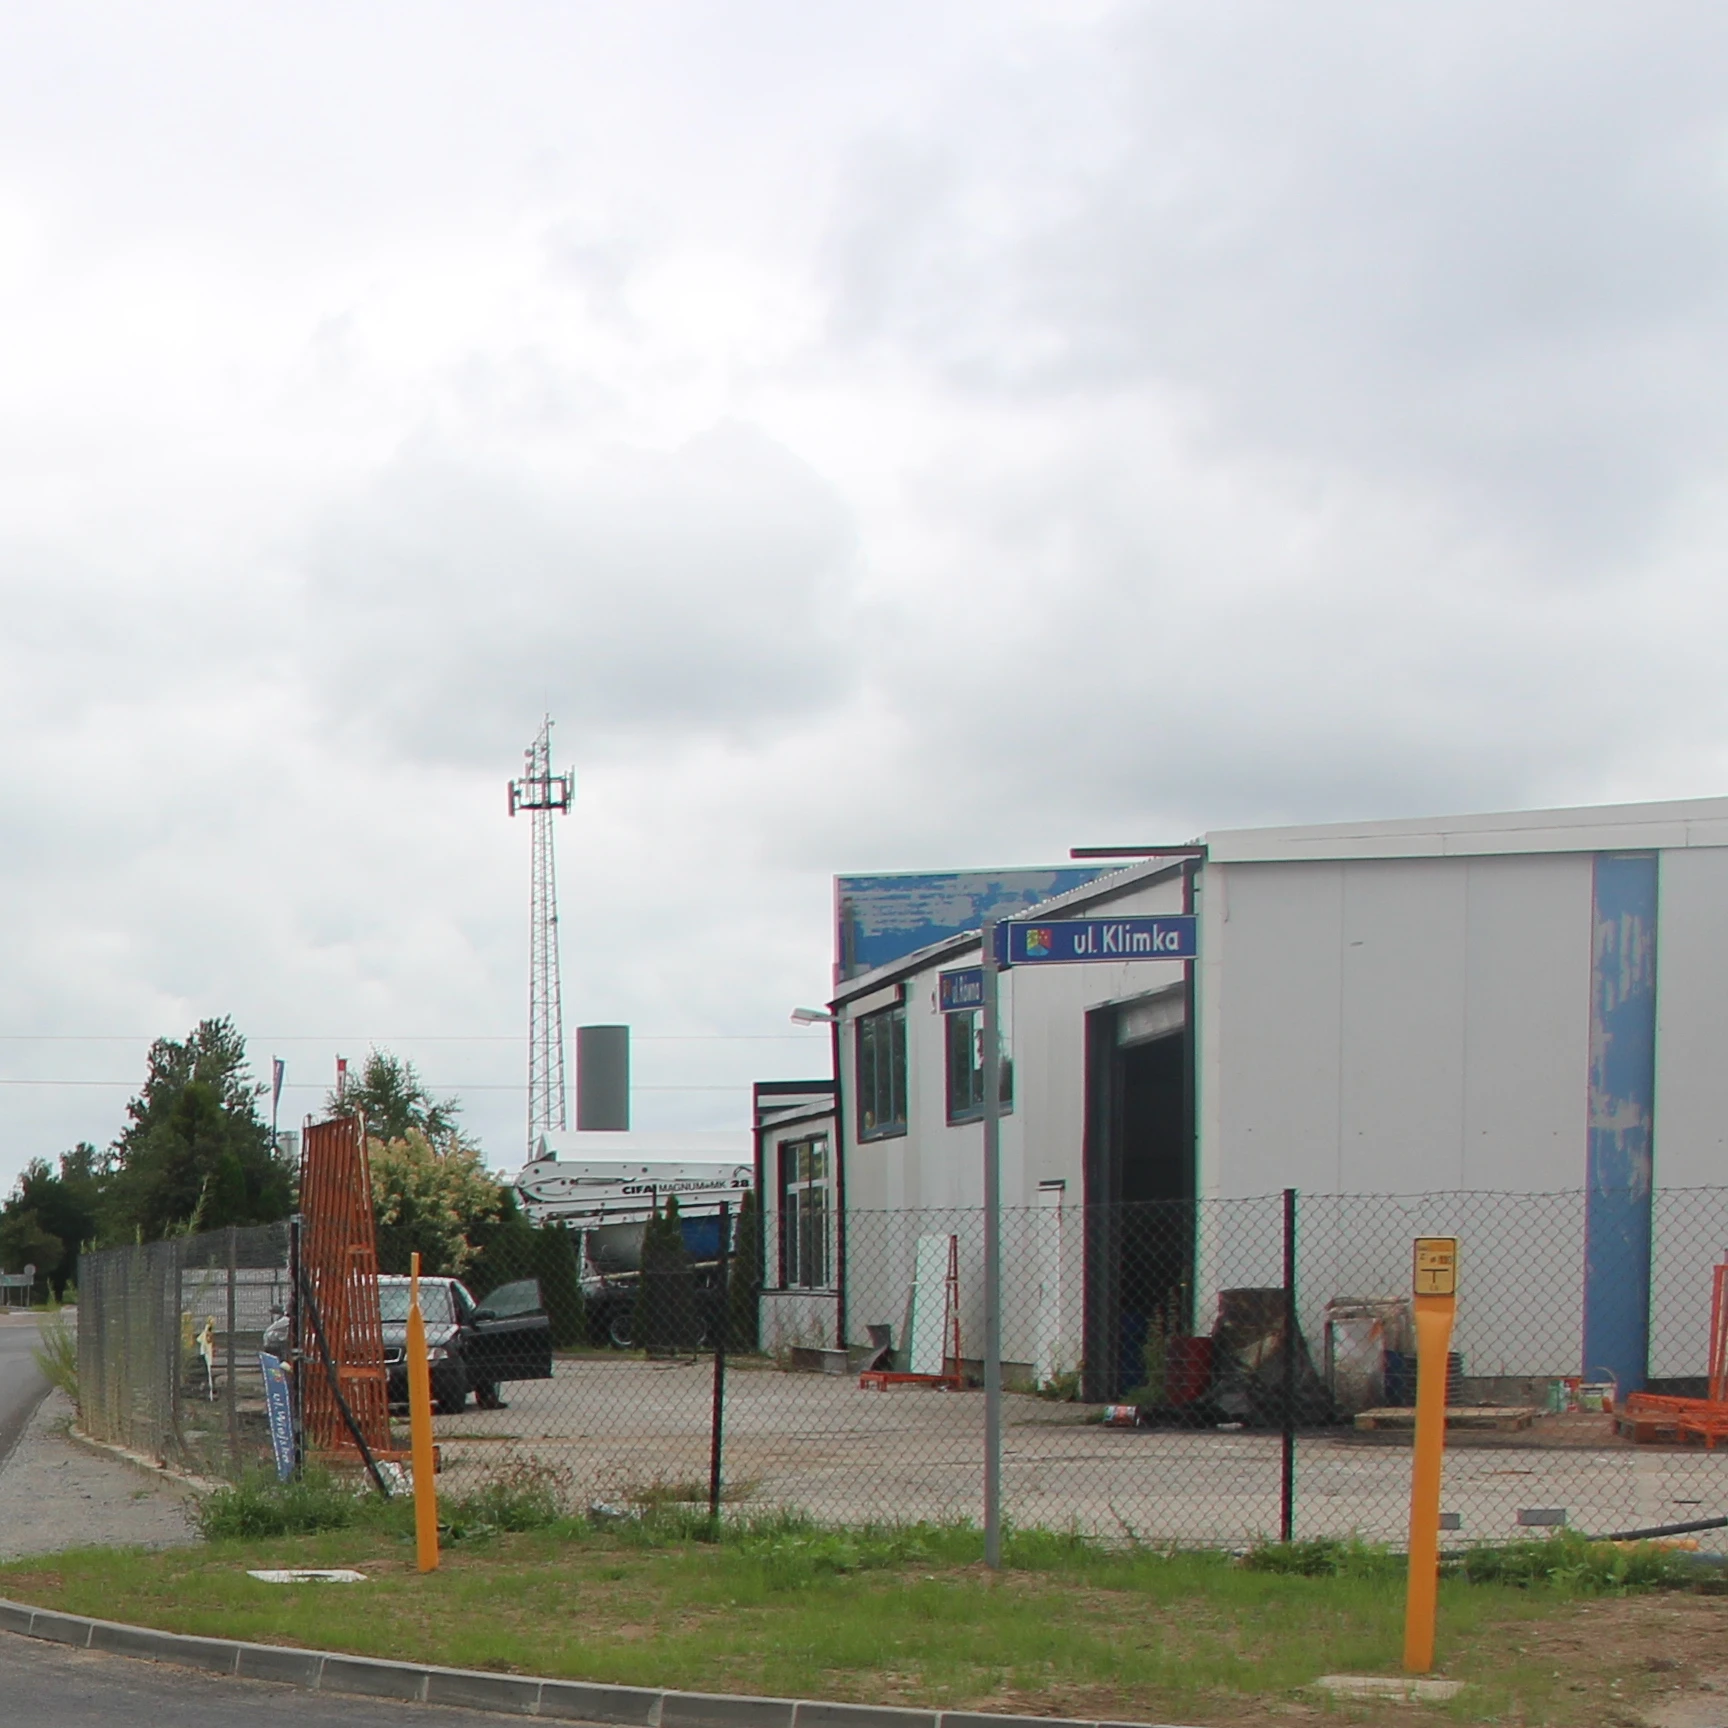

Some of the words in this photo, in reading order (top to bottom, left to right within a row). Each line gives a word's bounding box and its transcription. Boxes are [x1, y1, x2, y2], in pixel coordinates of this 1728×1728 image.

[1073, 925, 1098, 954] ul.
[1102, 923, 1180, 953] Klimka
[622, 1185, 653, 1194] CIFA
[731, 1180, 750, 1188] 28
[276, 1411, 290, 1464] Wiejska
